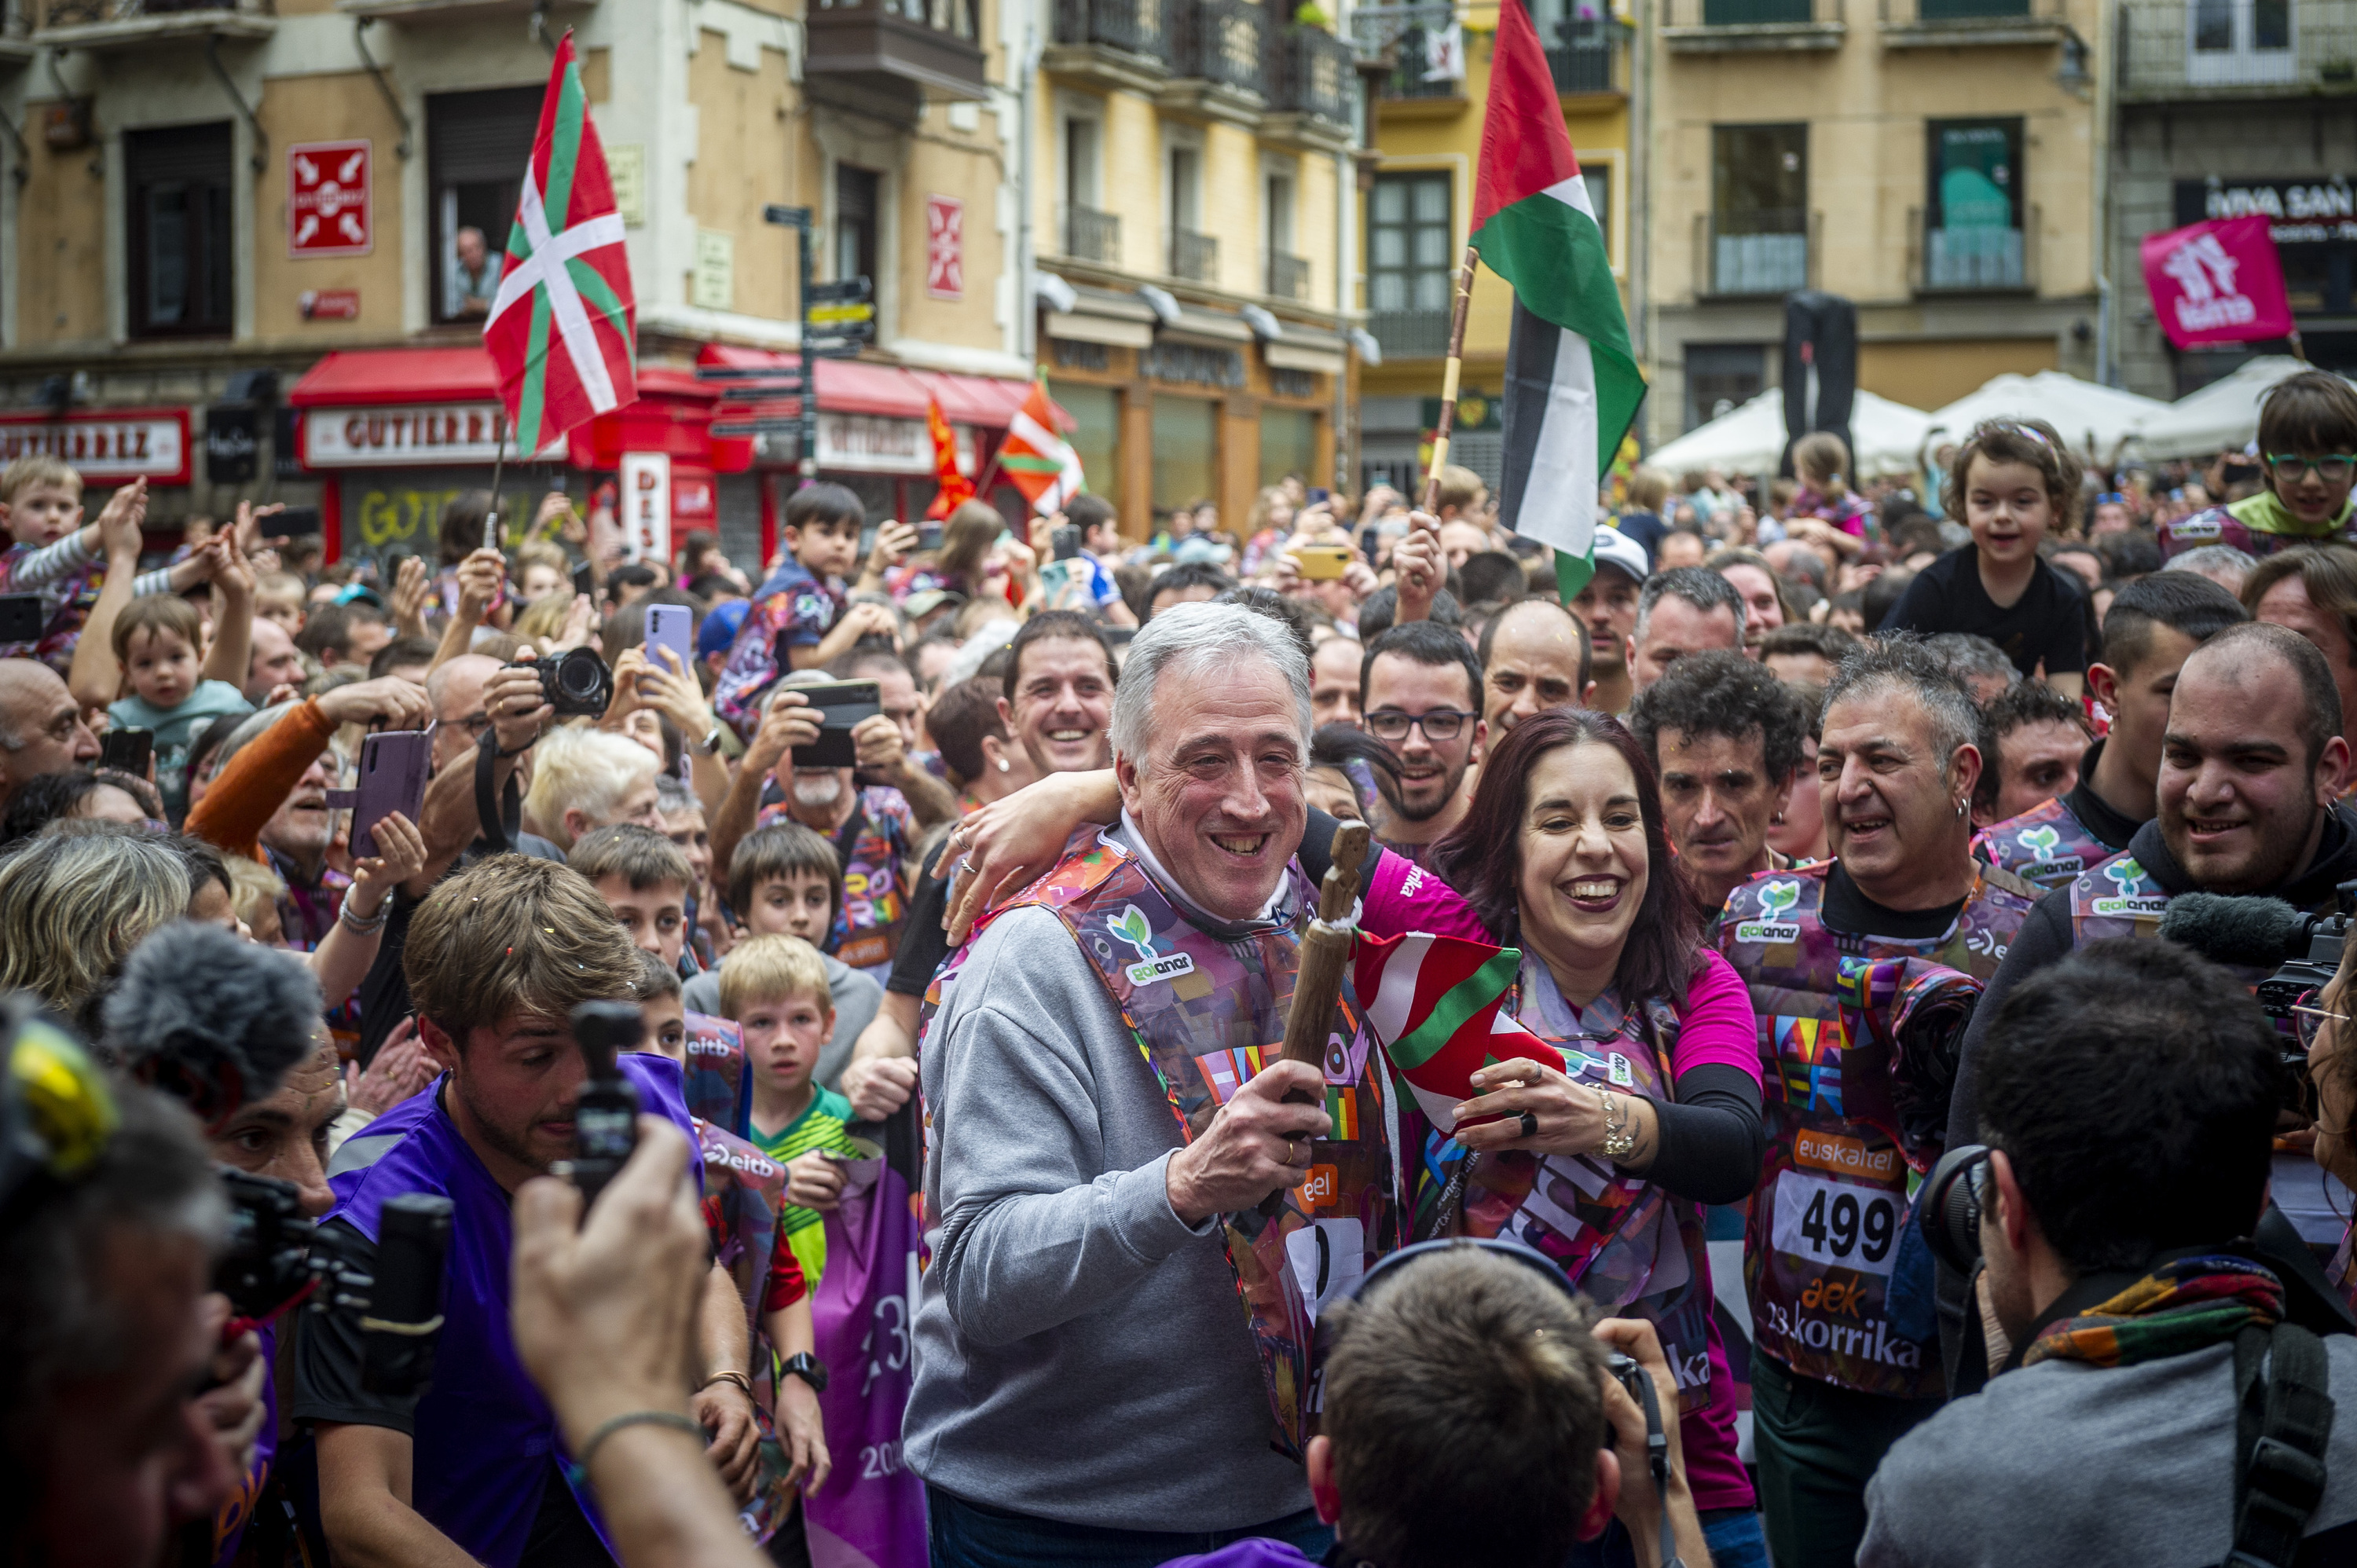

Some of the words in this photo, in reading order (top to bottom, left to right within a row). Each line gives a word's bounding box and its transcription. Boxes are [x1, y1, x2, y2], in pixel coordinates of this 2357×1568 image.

[1131, 956, 1189, 982] goiener
[687, 1037, 731, 1057] eitb
[730, 1156, 774, 1178] eitb
[1799, 1138, 1894, 1172] euskaltel
[1802, 1188, 1895, 1263] 499
[1802, 1273, 1867, 1319] aek
